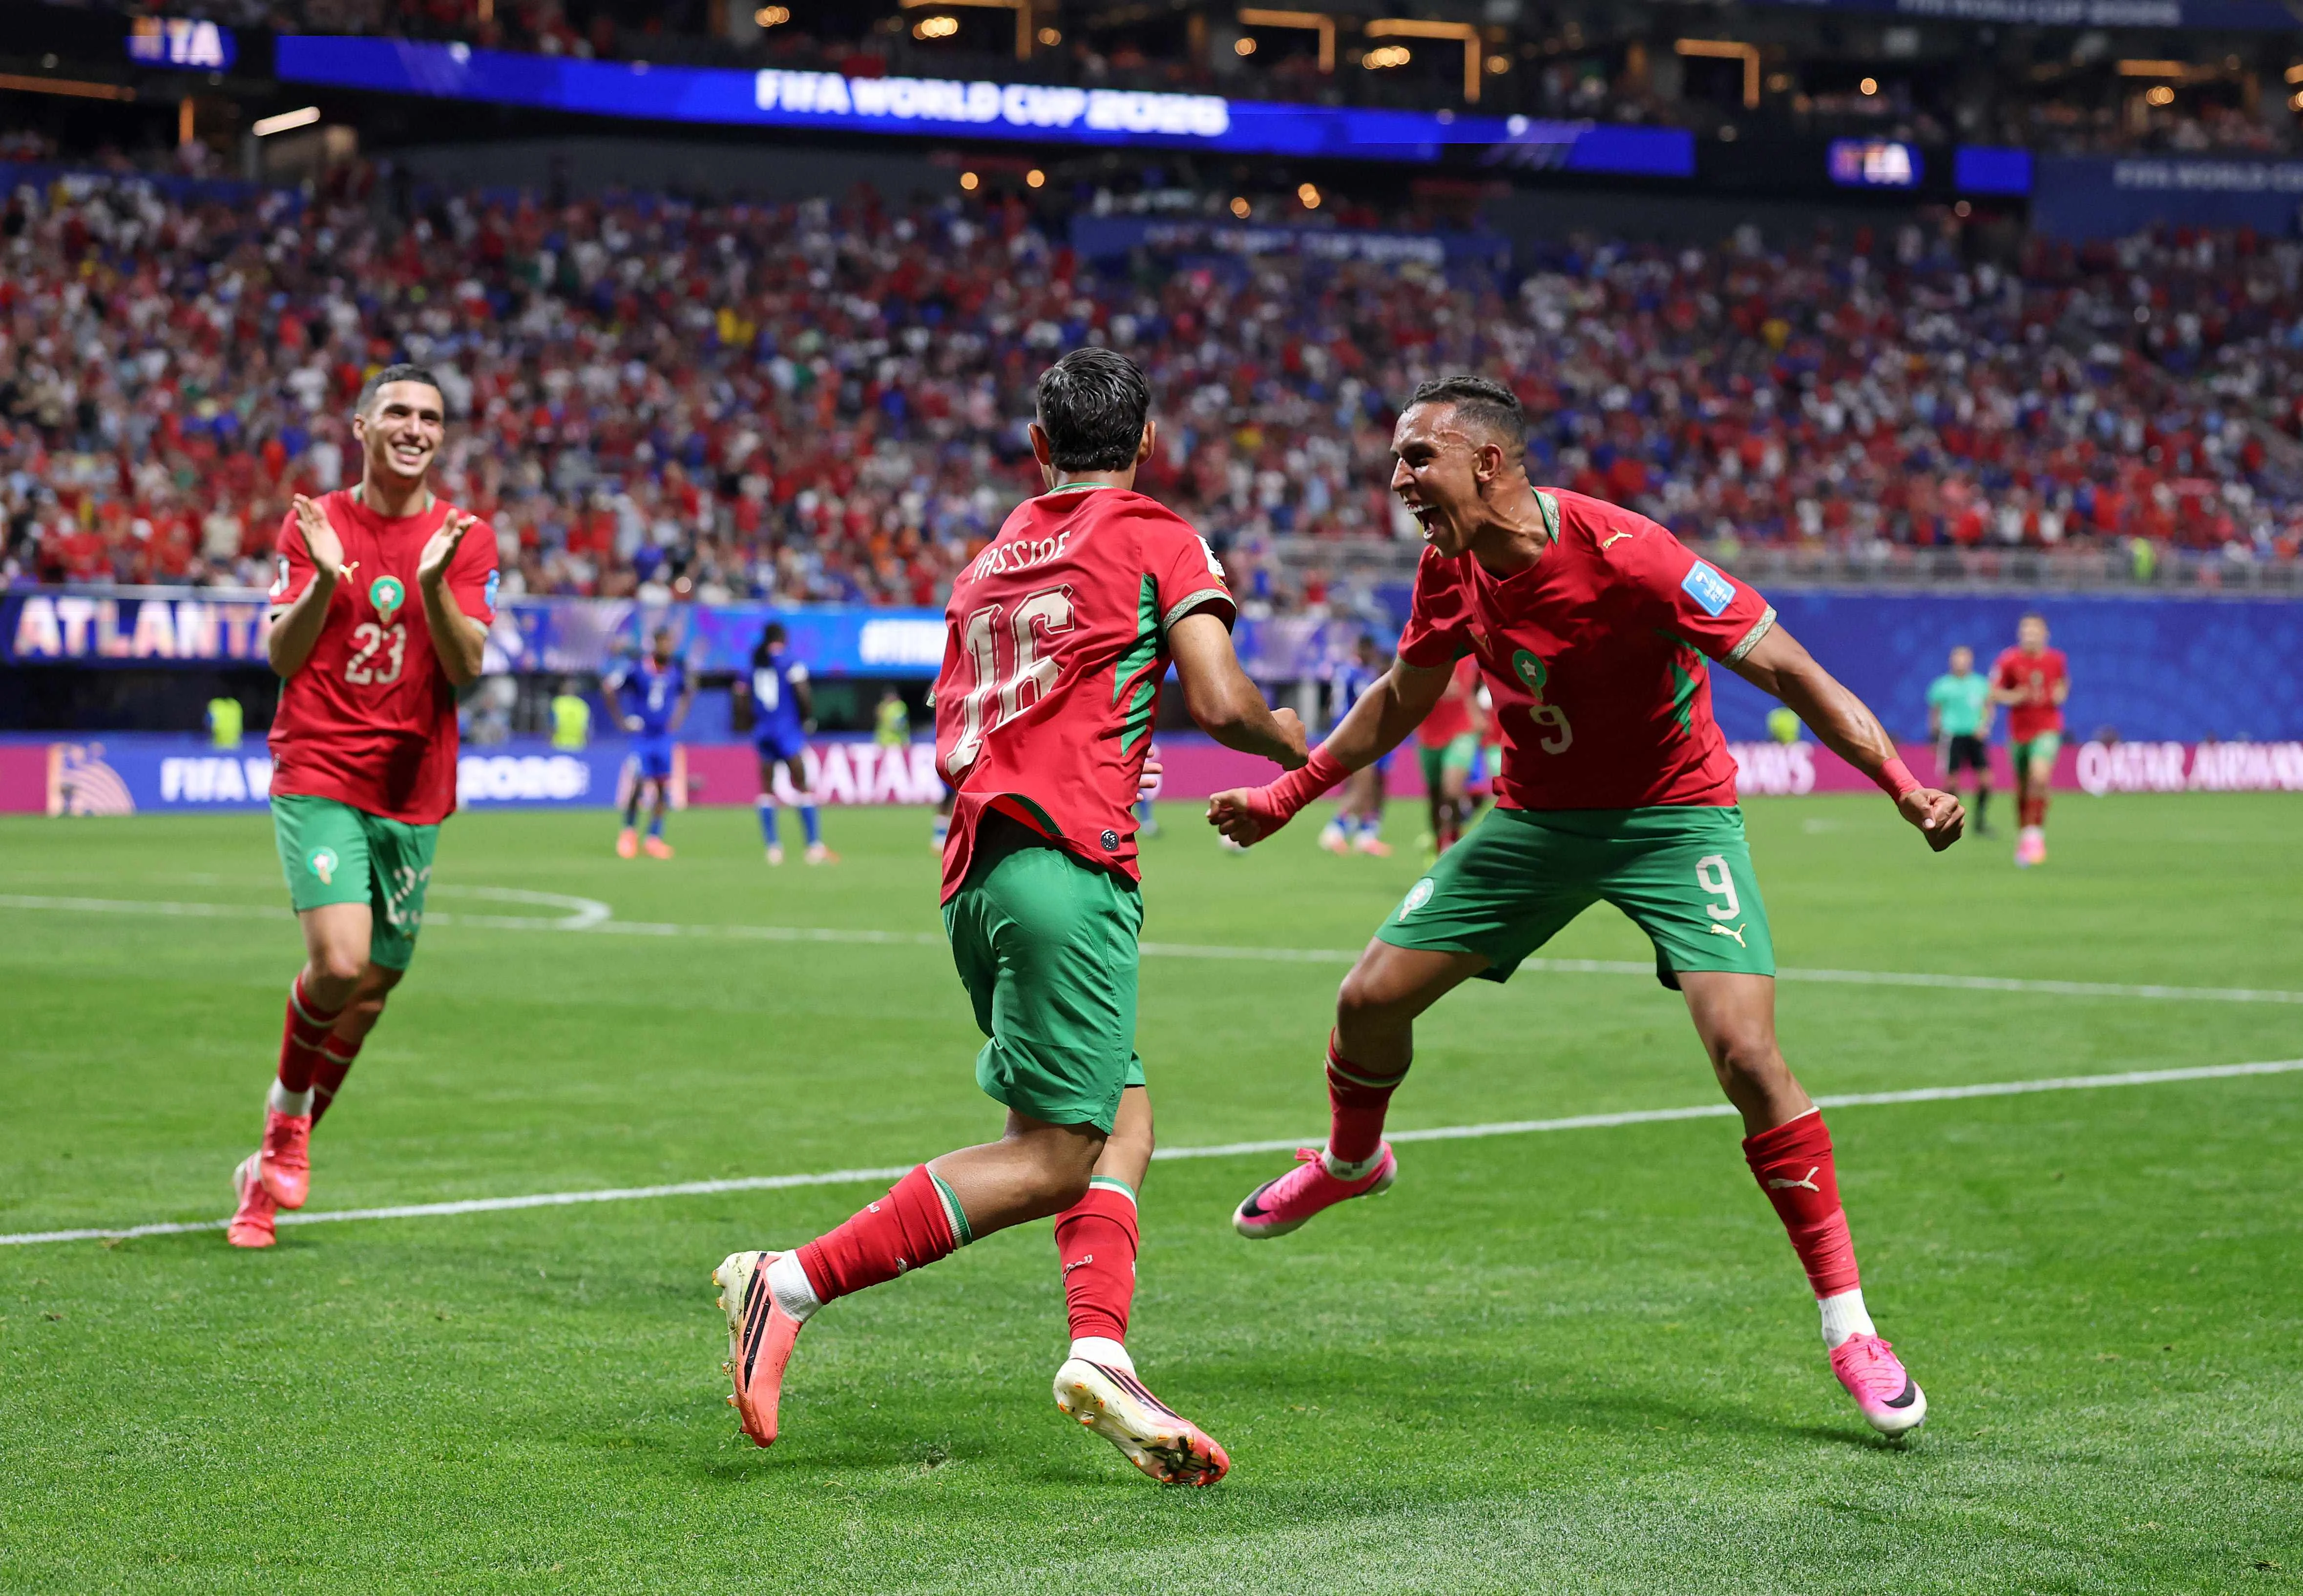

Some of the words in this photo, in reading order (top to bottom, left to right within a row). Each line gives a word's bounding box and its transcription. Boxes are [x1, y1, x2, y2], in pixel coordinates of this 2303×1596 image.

[755, 68, 852, 115] FIFA
[851, 76, 1002, 123] WORLD
[1002, 83, 1085, 128] CUP
[344, 622, 406, 685] 23
[945, 583, 1075, 784] 16
[1529, 704, 1573, 754] 9
[160, 757, 246, 802] FIFA
[772, 742, 946, 805] QATAR
[2075, 740, 2186, 796] QATAR
[1696, 854, 1740, 920] 9
